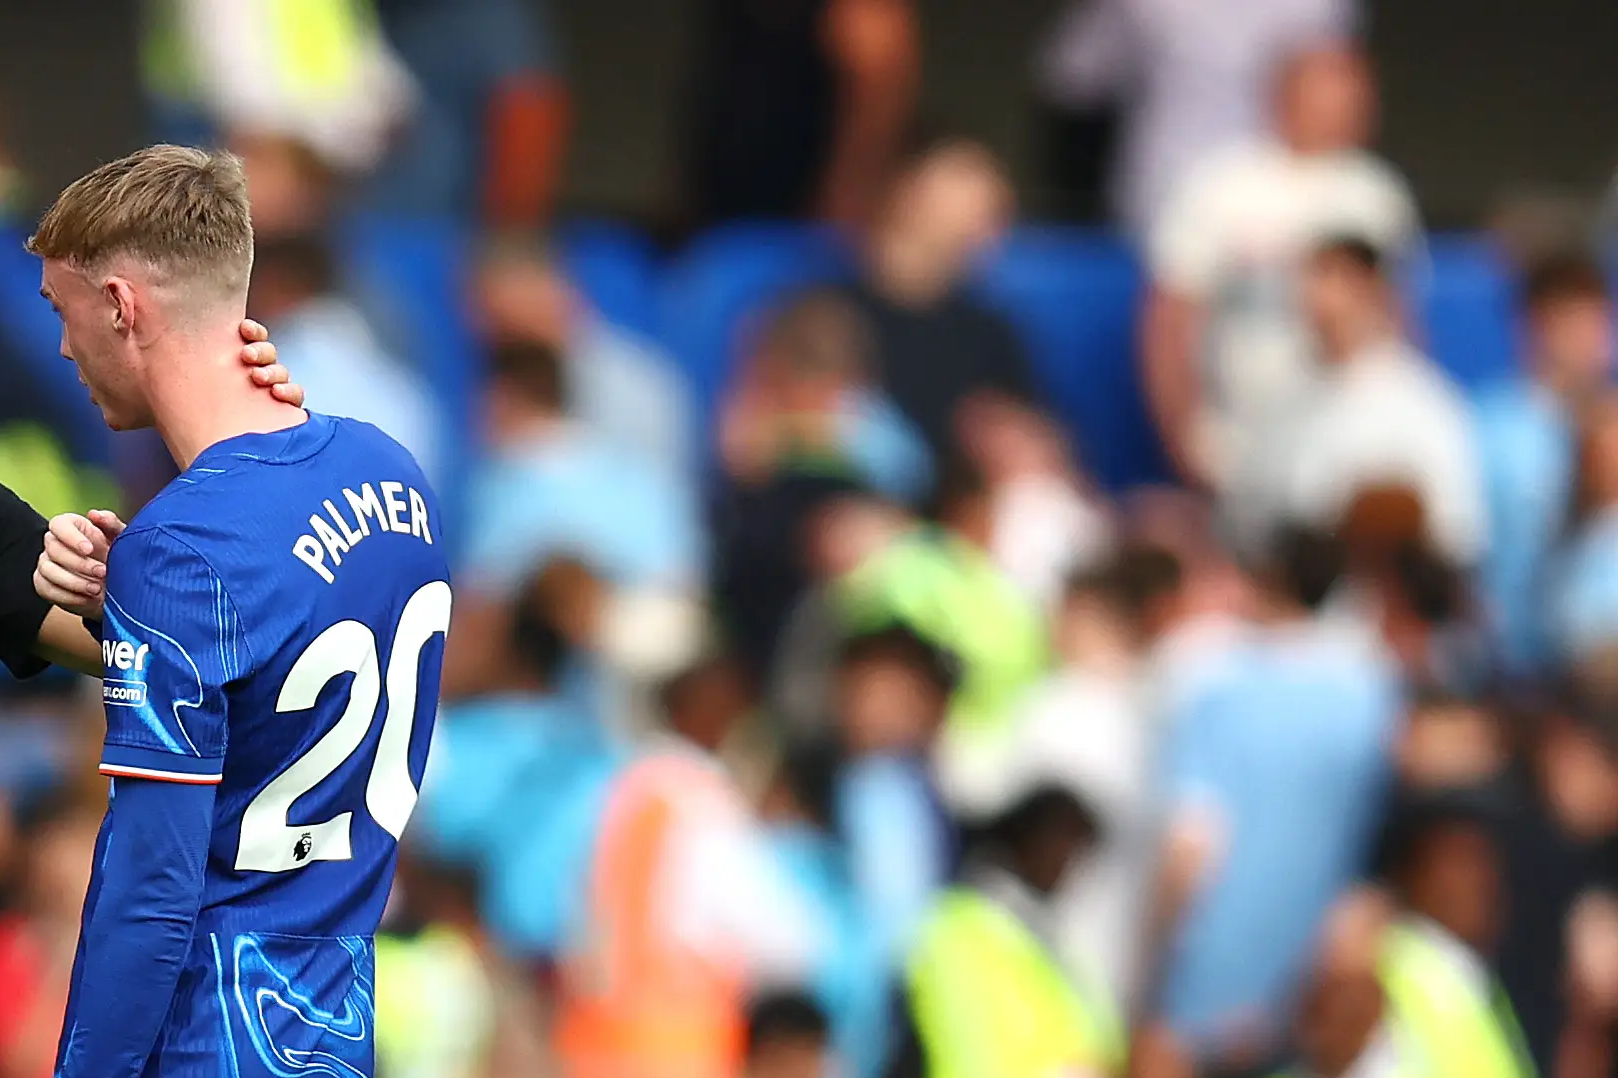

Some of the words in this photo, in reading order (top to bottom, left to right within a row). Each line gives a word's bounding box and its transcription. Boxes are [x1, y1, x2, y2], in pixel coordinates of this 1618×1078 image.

[293, 481, 433, 584] PALMER
[102, 639, 149, 671] ver
[234, 580, 452, 873] 20
